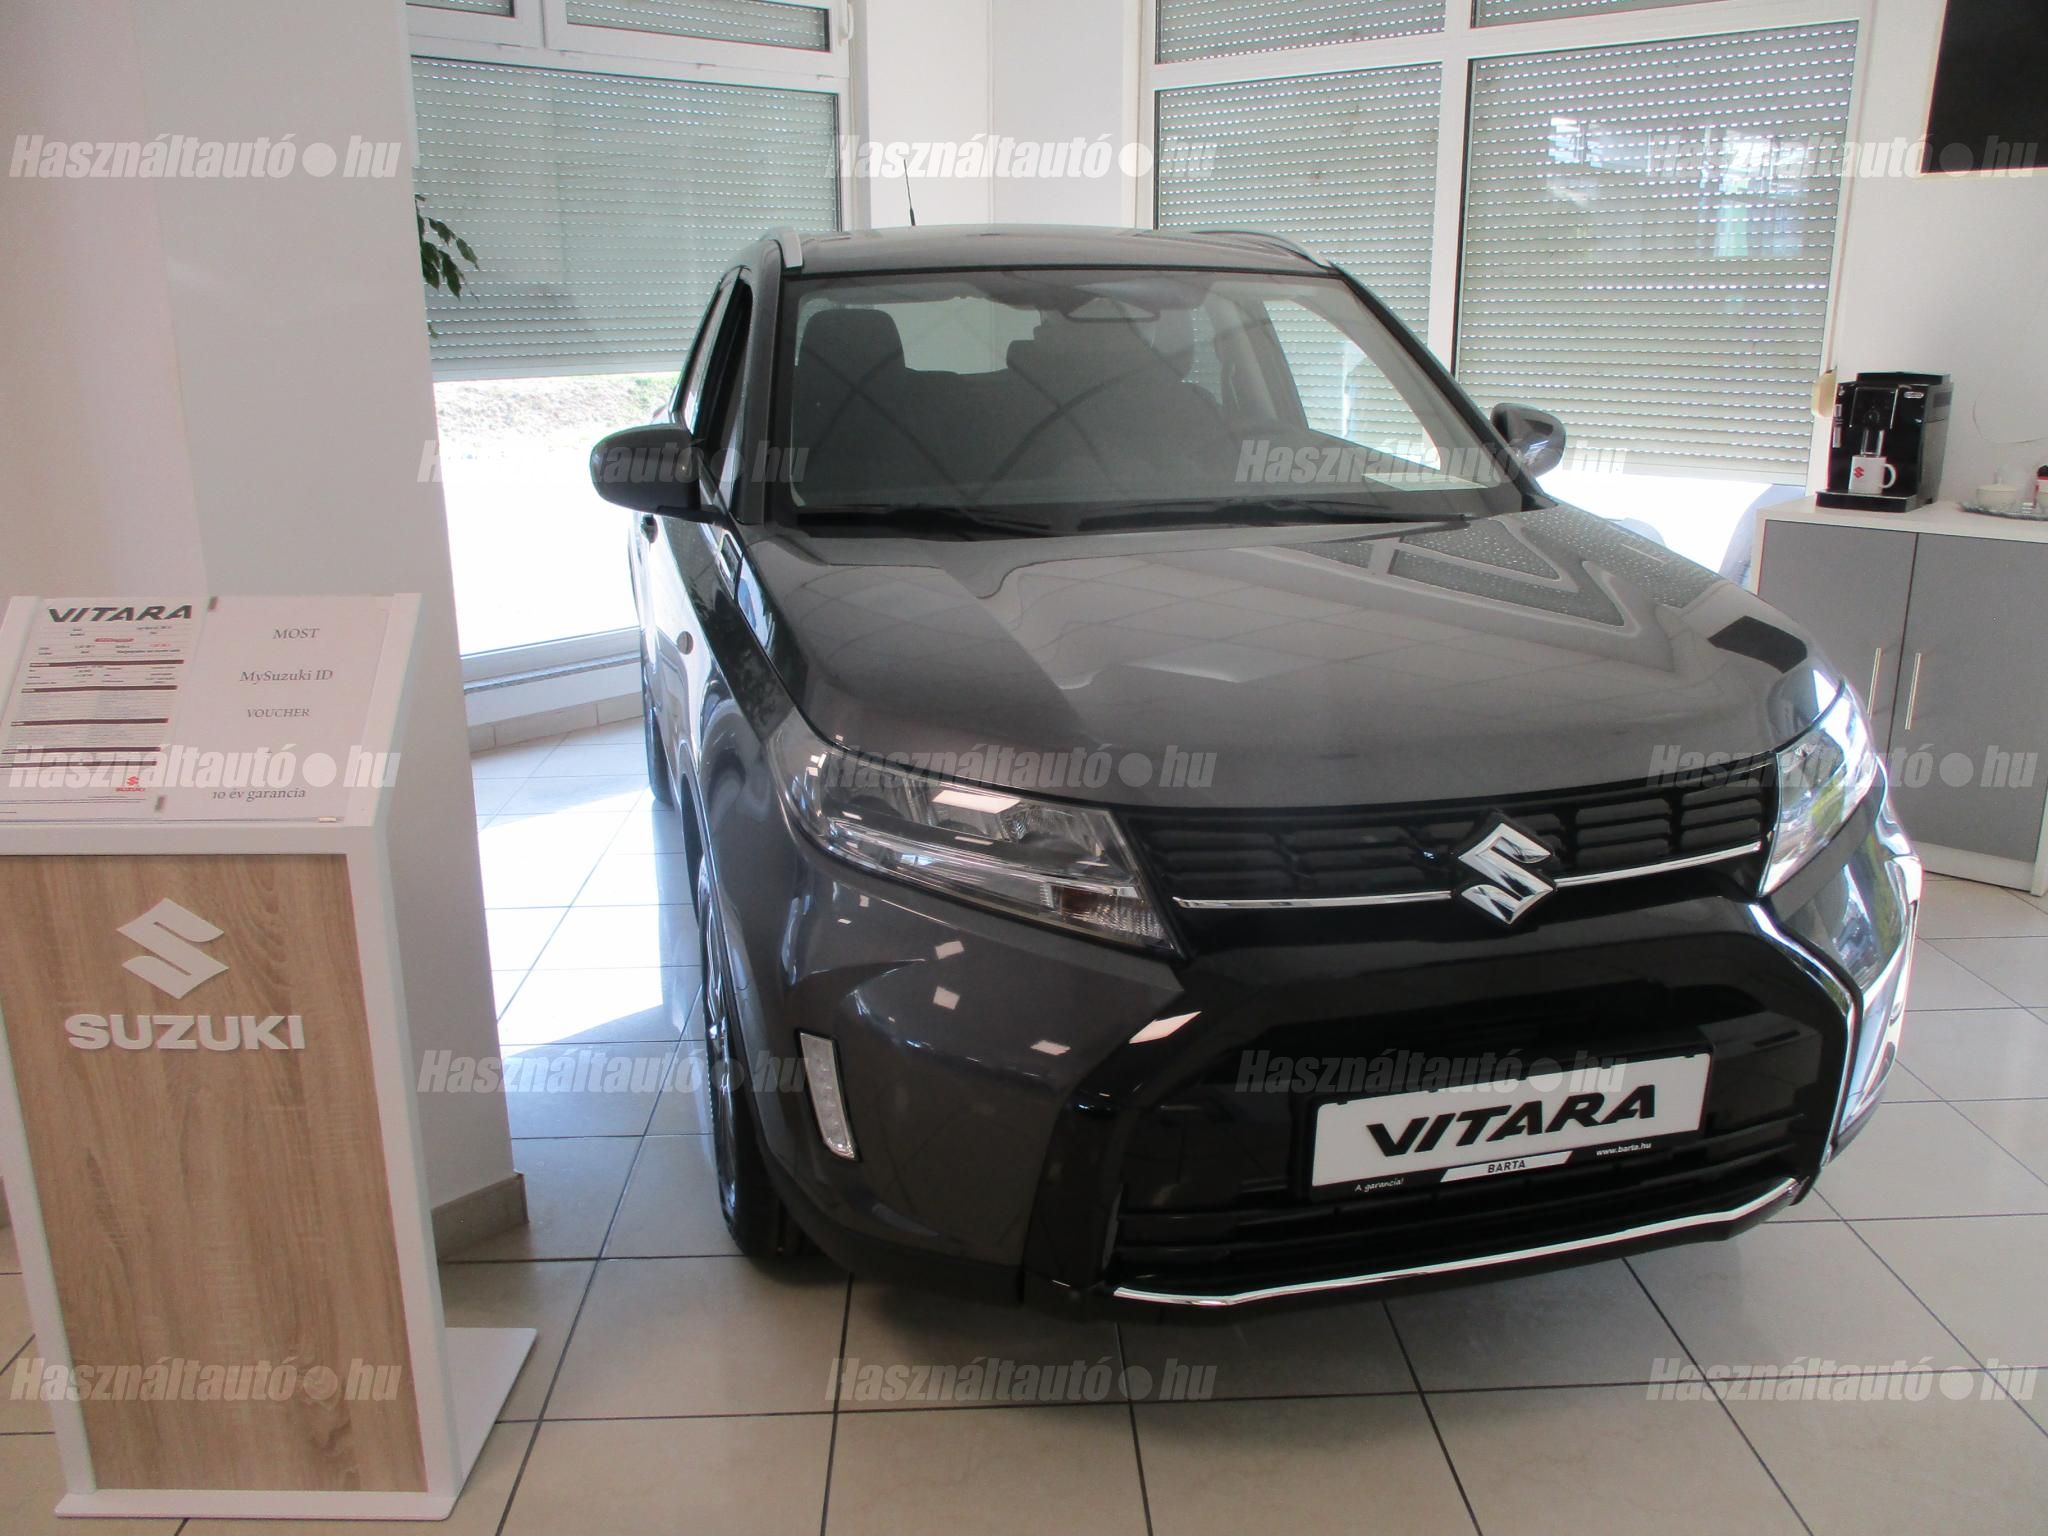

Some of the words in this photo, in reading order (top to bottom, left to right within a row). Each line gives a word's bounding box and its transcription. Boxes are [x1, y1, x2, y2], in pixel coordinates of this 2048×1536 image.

[48, 605, 192, 622] VITARA
[272, 628, 320, 639] MOST
[240, 669, 312, 685] MySuzuki
[314, 669, 334, 680] ID
[247, 708, 310, 718] VOUCHER
[212, 791, 226, 799] 10
[229, 788, 244, 799] év
[246, 788, 306, 802] garancia
[64, 1014, 305, 1050] SUZUKI
[1366, 1084, 1656, 1157] VITARA
[1596, 1142, 1652, 1156] www.barta.hu
[1487, 1159, 1526, 1173] BARTA
